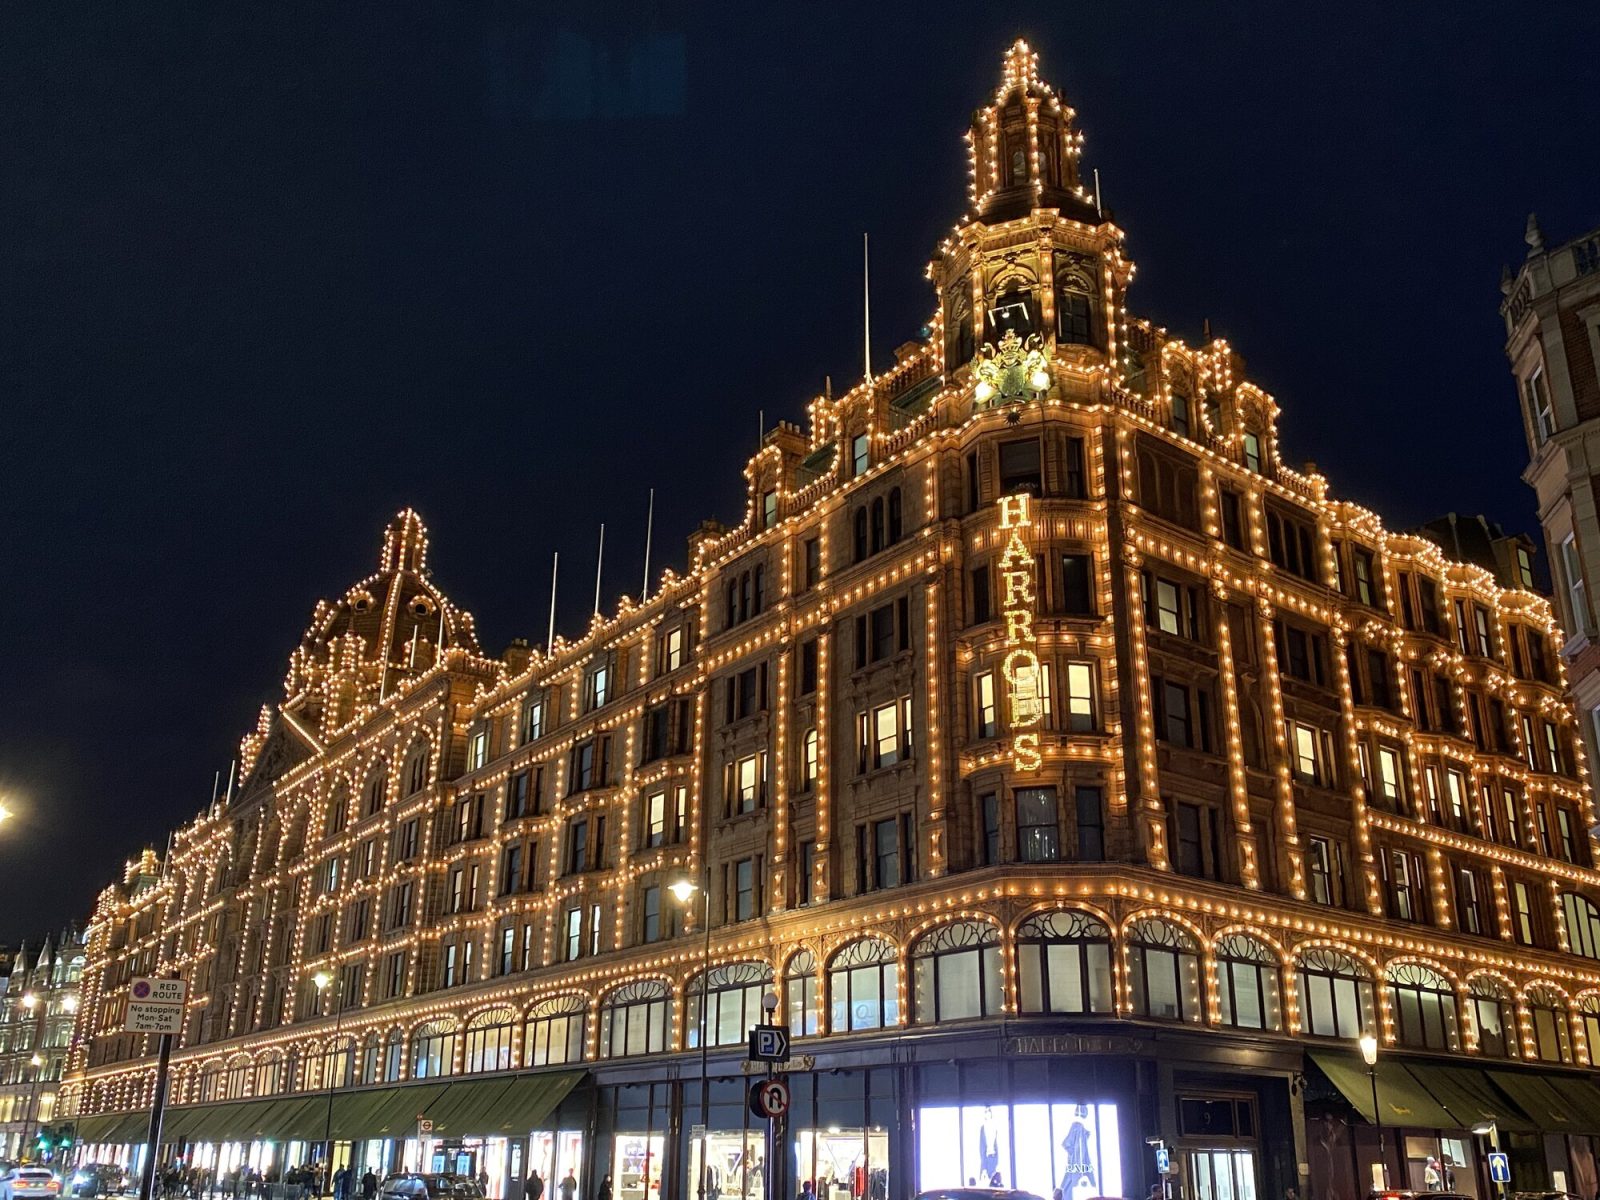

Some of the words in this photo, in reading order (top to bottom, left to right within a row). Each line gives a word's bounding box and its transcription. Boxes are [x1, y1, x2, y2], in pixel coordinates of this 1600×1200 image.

[996, 493, 1042, 772] HARRODS
[159, 983, 178, 991] RED
[152, 991, 182, 999] ROUTE
[130, 1004, 142, 1012] No
[144, 1005, 181, 1014] stopping
[137, 1014, 172, 1022] Mon-Sat
[135, 1022, 172, 1031] 7am-7pm
[760, 1033, 772, 1053] P
